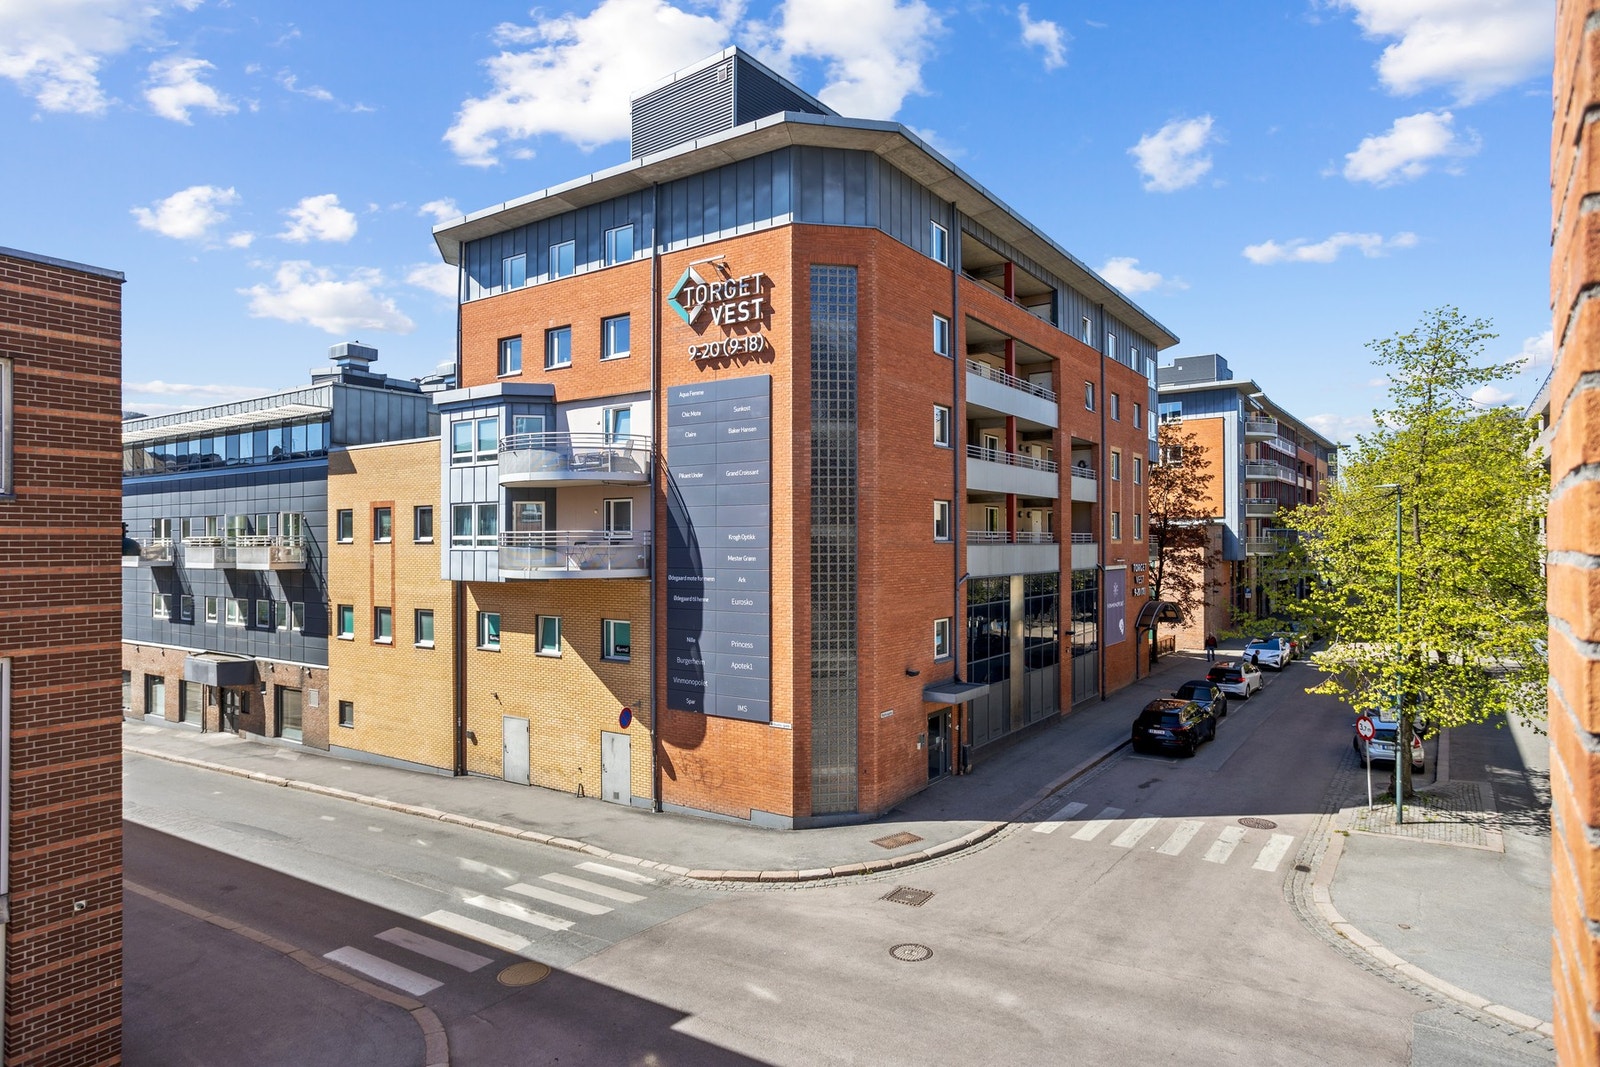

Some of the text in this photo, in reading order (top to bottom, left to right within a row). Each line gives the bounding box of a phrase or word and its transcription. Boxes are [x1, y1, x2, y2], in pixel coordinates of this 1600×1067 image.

[683, 272, 764, 307] TORGET
[710, 298, 764, 326] VEST
[688, 332, 765, 361] 9-20 (9-18)
[733, 405, 751, 413] Sunkost
[731, 598, 754, 606] Eurosko
[730, 640, 754, 649] Princess
[676, 656, 706, 666] Burgerheim
[730, 661, 753, 671] Apotek1
[672, 676, 709, 687] Vinmonopolet
[686, 697, 696, 705] Spar
[737, 704, 748, 712] IMS
